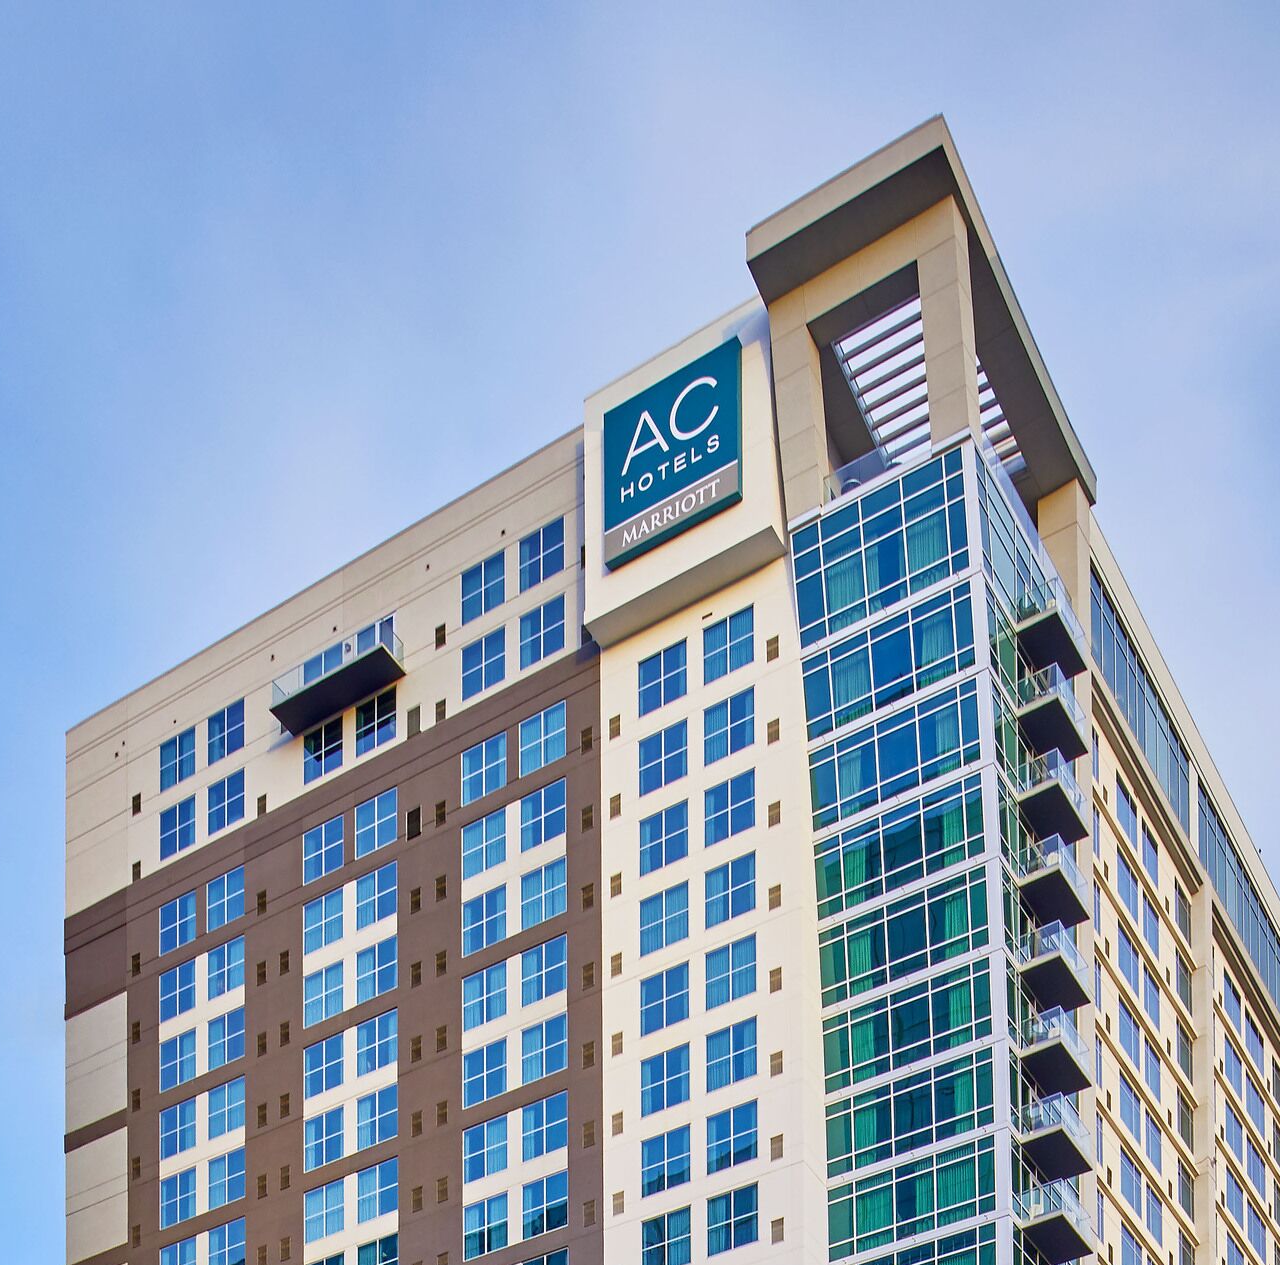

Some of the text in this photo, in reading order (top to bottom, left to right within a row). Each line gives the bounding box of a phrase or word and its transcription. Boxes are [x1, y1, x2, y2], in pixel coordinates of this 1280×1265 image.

[621, 375, 719, 476] AC
[620, 434, 720, 504] HOTELS
[621, 478, 720, 548] MARRIOTT
